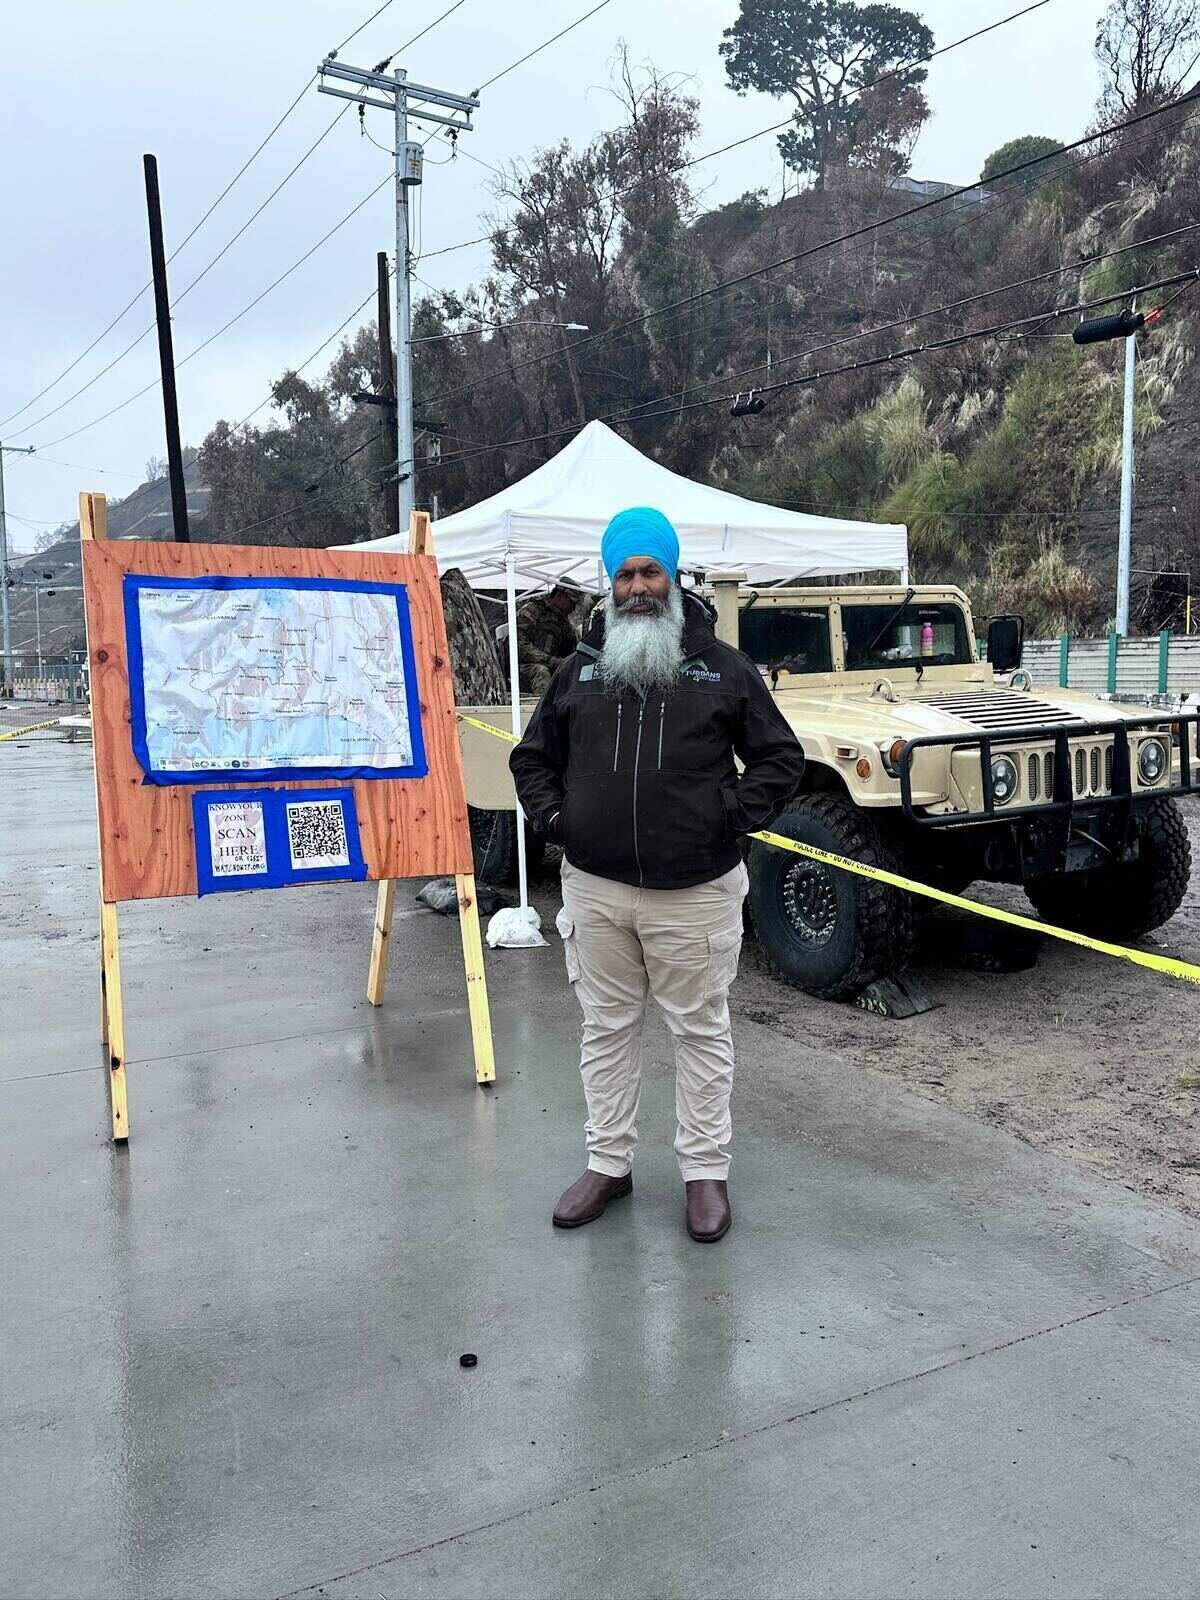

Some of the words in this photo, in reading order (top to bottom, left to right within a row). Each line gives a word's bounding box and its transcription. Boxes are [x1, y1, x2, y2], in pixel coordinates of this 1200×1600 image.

[686, 670, 721, 679] TURBANS
[693, 675, 700, 683] 4
[218, 828, 256, 839] SCAN
[220, 845, 258, 856] HERE
[793, 842, 814, 854] POLICE
[815, 848, 828, 859] LINE
[842, 858, 854, 867] NOT
[856, 862, 877, 874] CROSS
